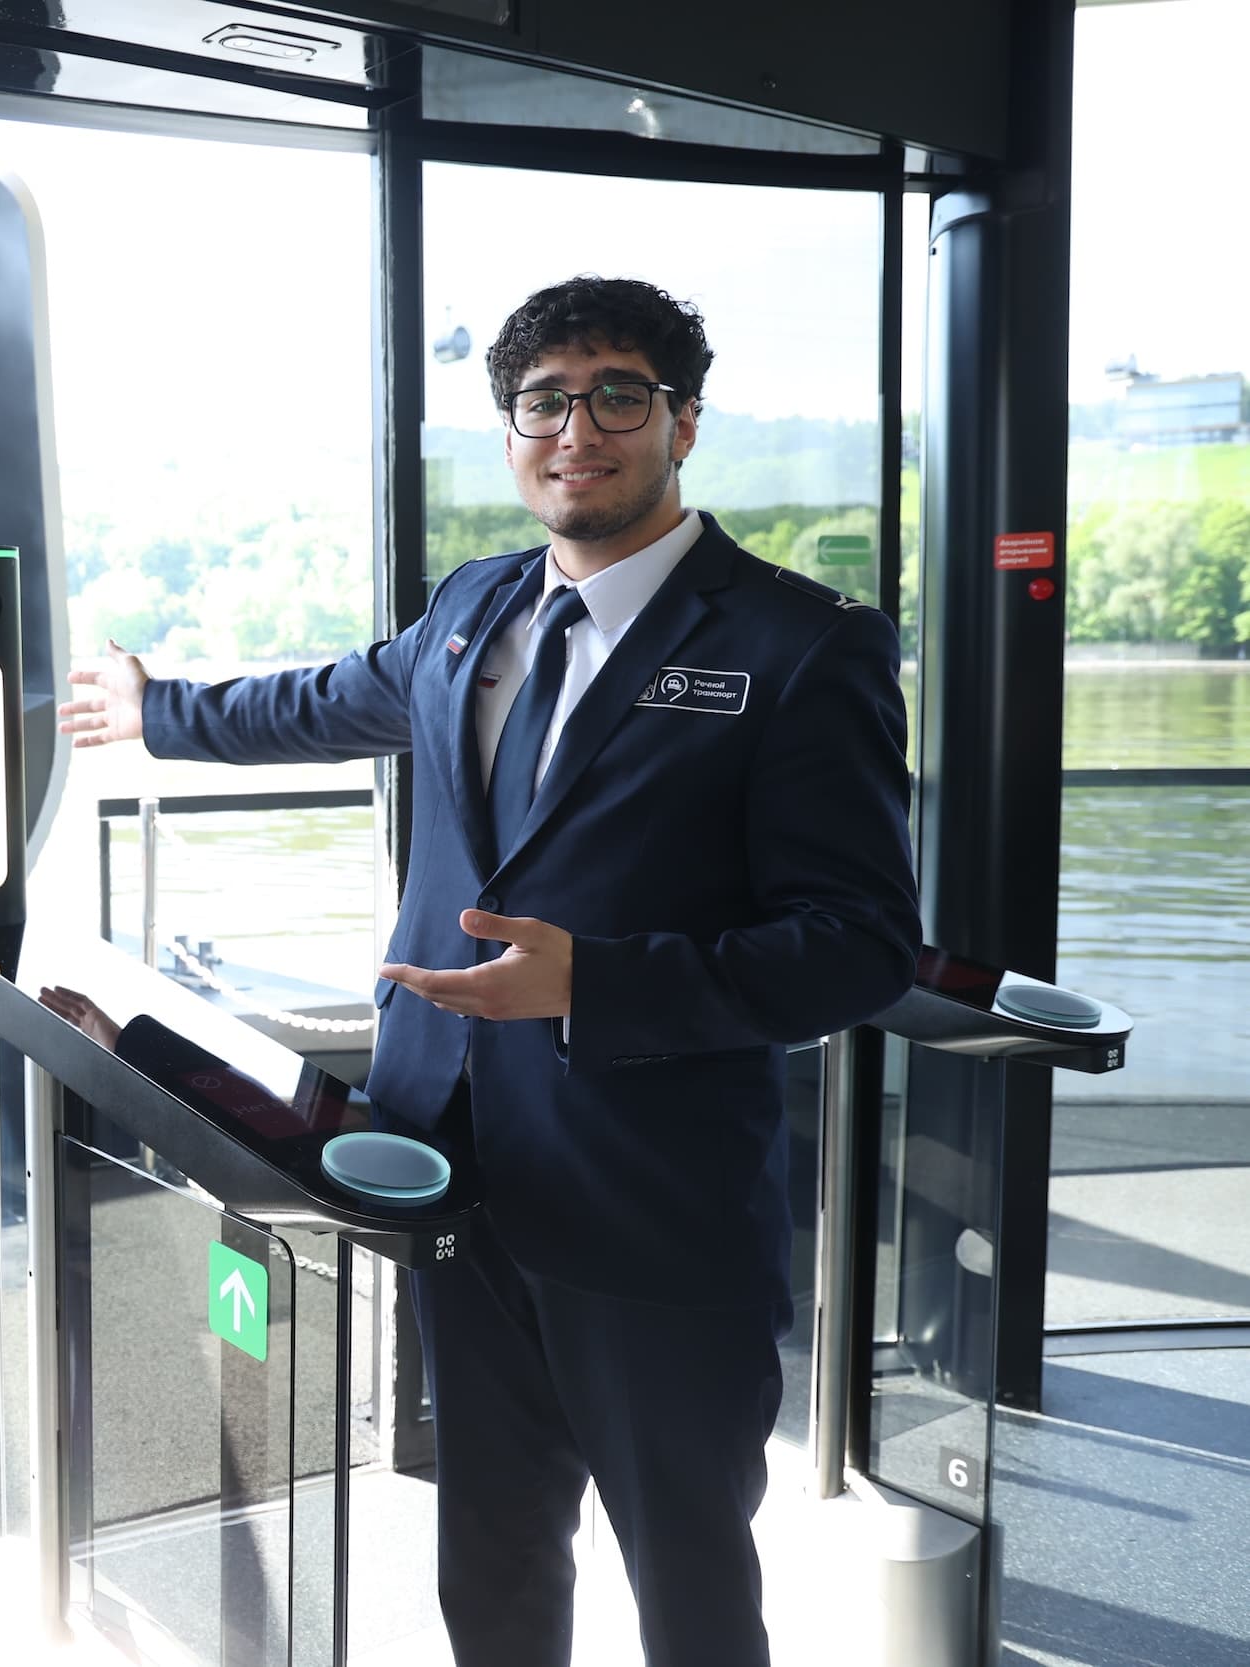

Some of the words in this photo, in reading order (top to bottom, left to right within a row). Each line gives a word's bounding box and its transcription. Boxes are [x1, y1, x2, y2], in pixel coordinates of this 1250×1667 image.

[694, 679, 726, 689] Речной
[693, 689, 738, 699] транспорт
[948, 1458, 968, 1488] 6
